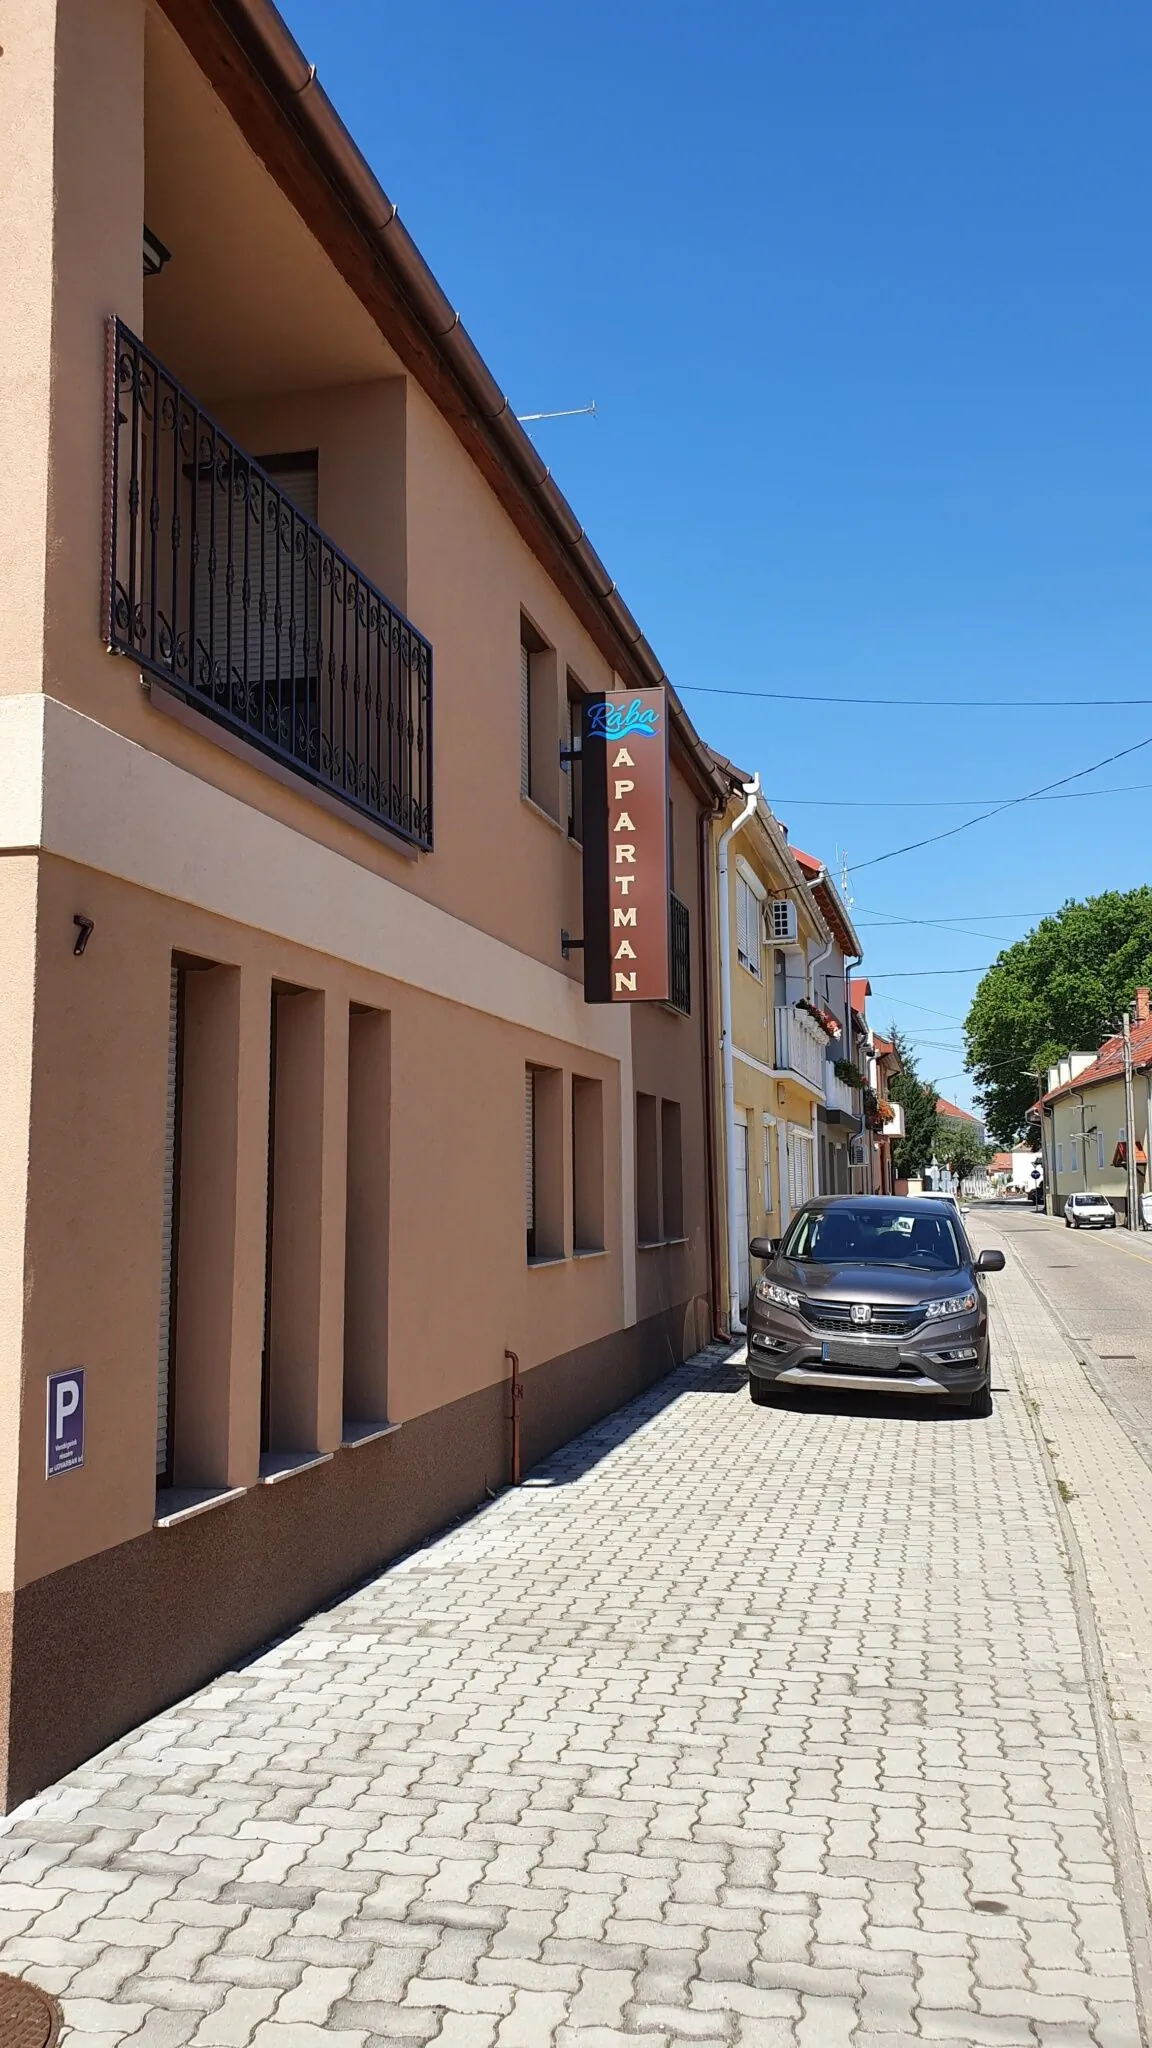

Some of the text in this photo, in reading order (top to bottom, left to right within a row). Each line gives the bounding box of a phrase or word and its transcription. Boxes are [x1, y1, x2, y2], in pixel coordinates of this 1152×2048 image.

[587, 698, 660, 732] Rába
[612, 747, 638, 992] APARTMAN
[56, 1380, 80, 1439] P
